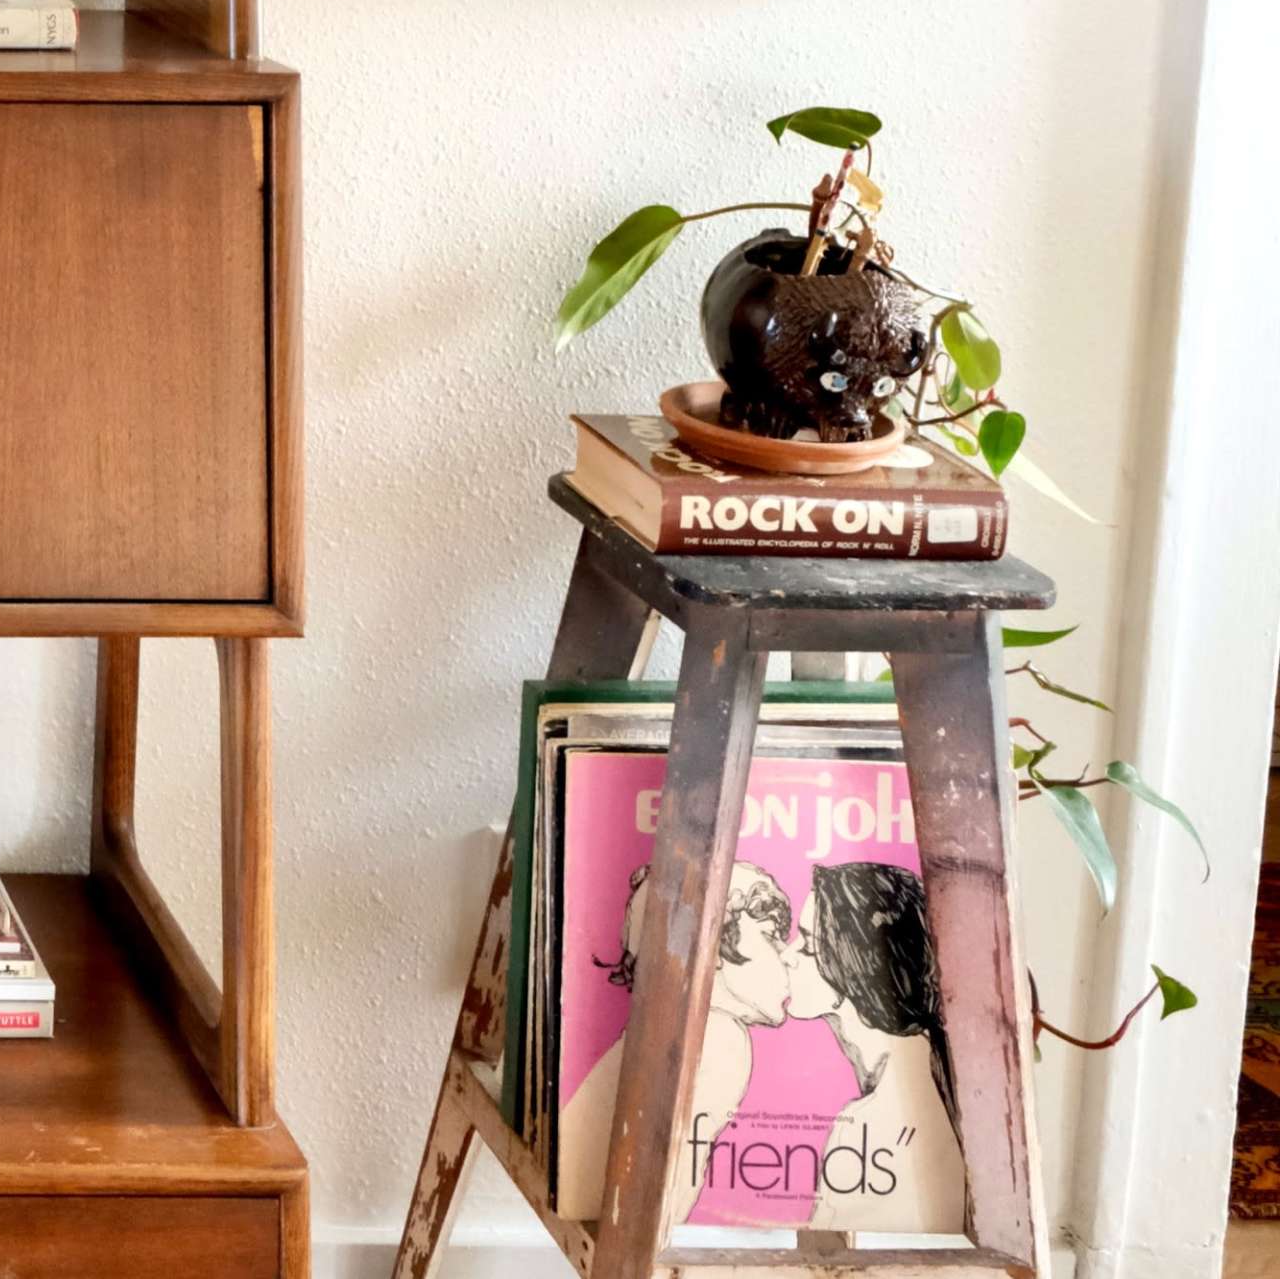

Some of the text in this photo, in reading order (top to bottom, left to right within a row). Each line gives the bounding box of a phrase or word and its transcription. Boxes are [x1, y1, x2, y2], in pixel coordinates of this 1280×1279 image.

[679, 495, 819, 534] ROCK
[831, 499, 905, 536] ON
[683, 537, 701, 545] THE
[702, 537, 755, 547] ILLUSTRATED
[756, 538, 819, 549] ENCYCLOPEDIA
[820, 540, 834, 549] OF
[835, 540, 860, 551] ROCK
[873, 541, 895, 552] ROLL
[726, 1110, 761, 1121] Original
